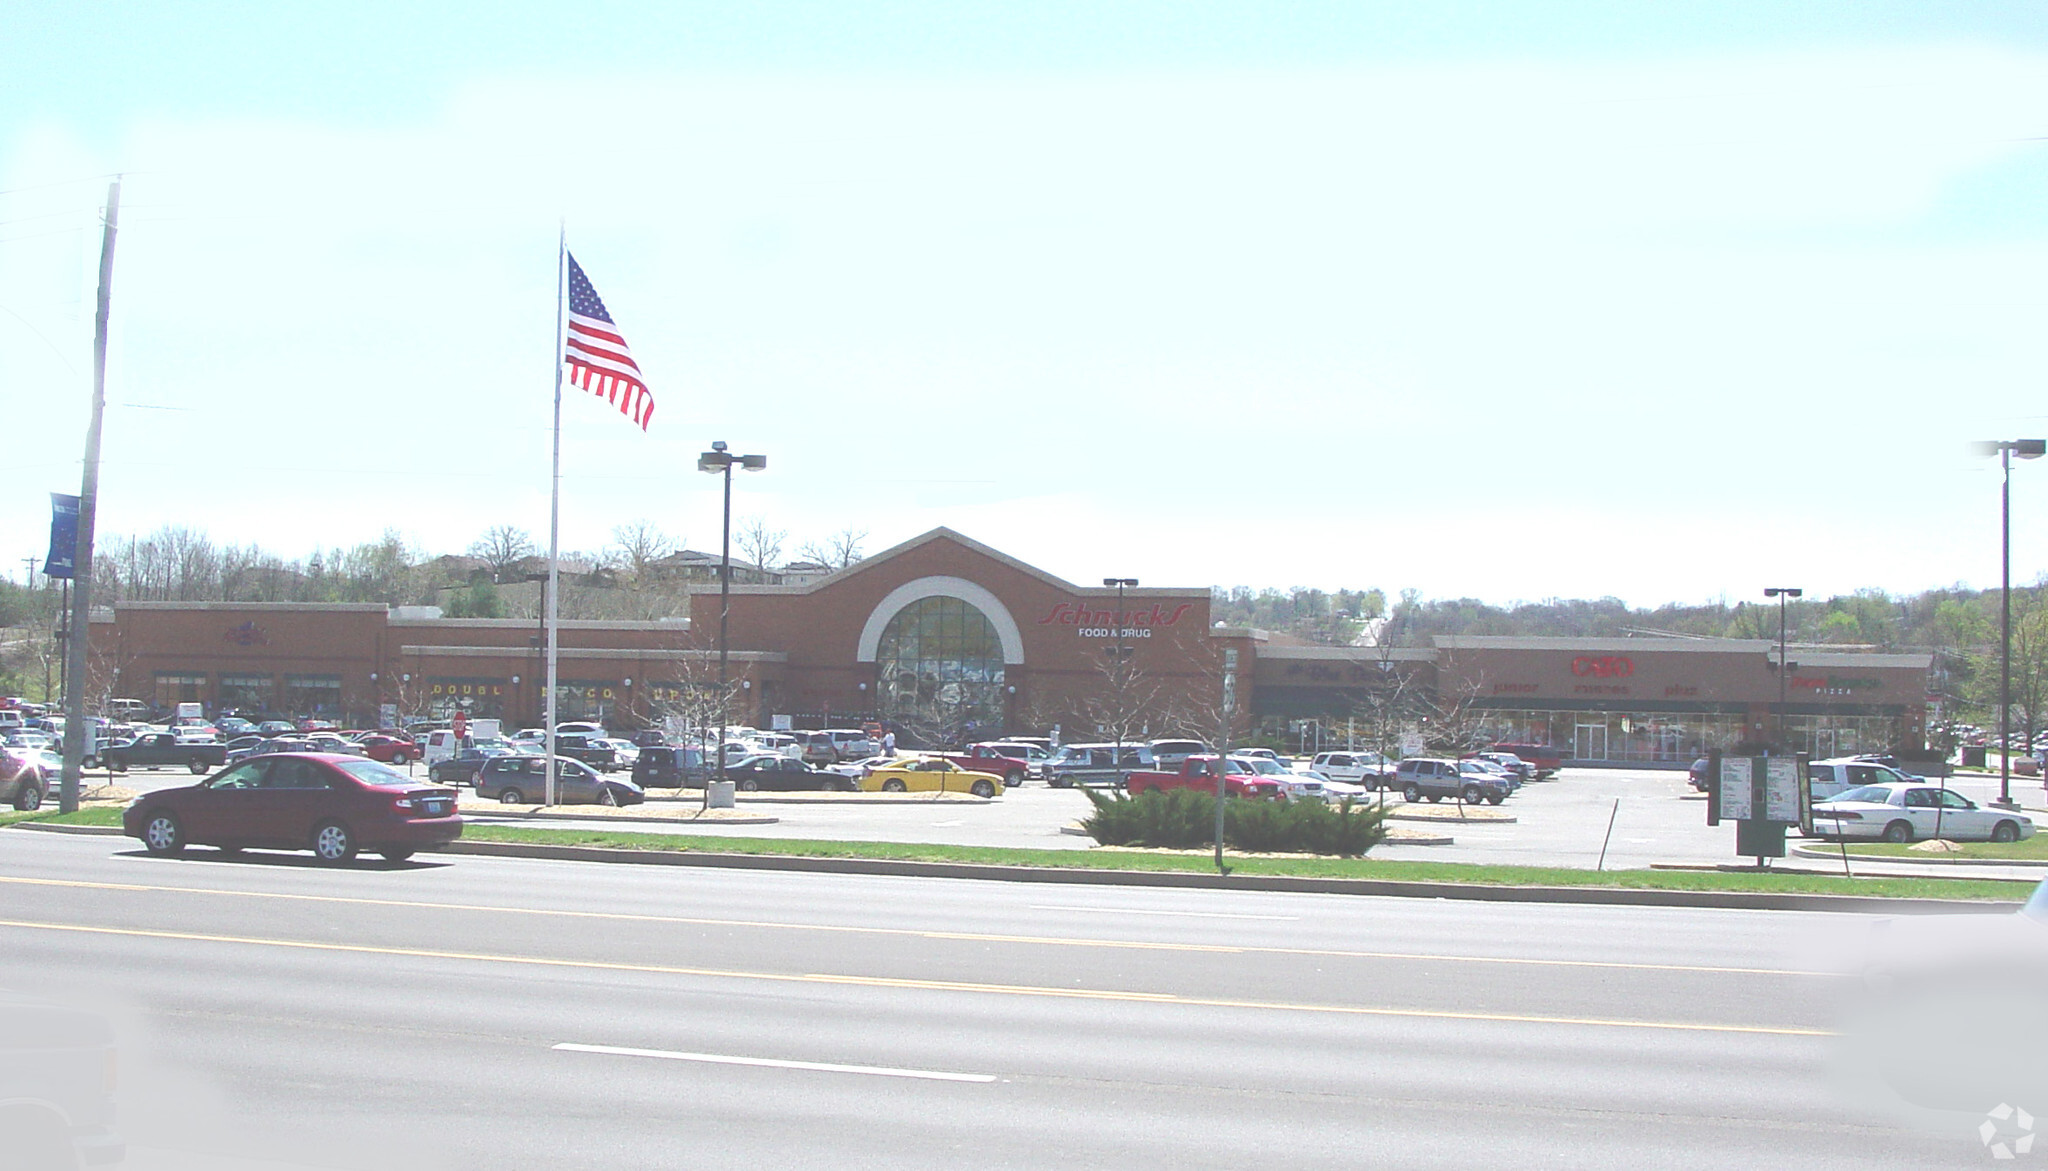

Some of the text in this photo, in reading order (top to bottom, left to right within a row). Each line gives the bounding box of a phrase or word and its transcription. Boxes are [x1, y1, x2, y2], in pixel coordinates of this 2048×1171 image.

[1078, 628, 1108, 638] FOOD
[1121, 628, 1152, 638] DRUG
[1571, 656, 1635, 678] CATO
[1815, 687, 1852, 695] PIZZA
[453, 720, 466, 731] STOP
